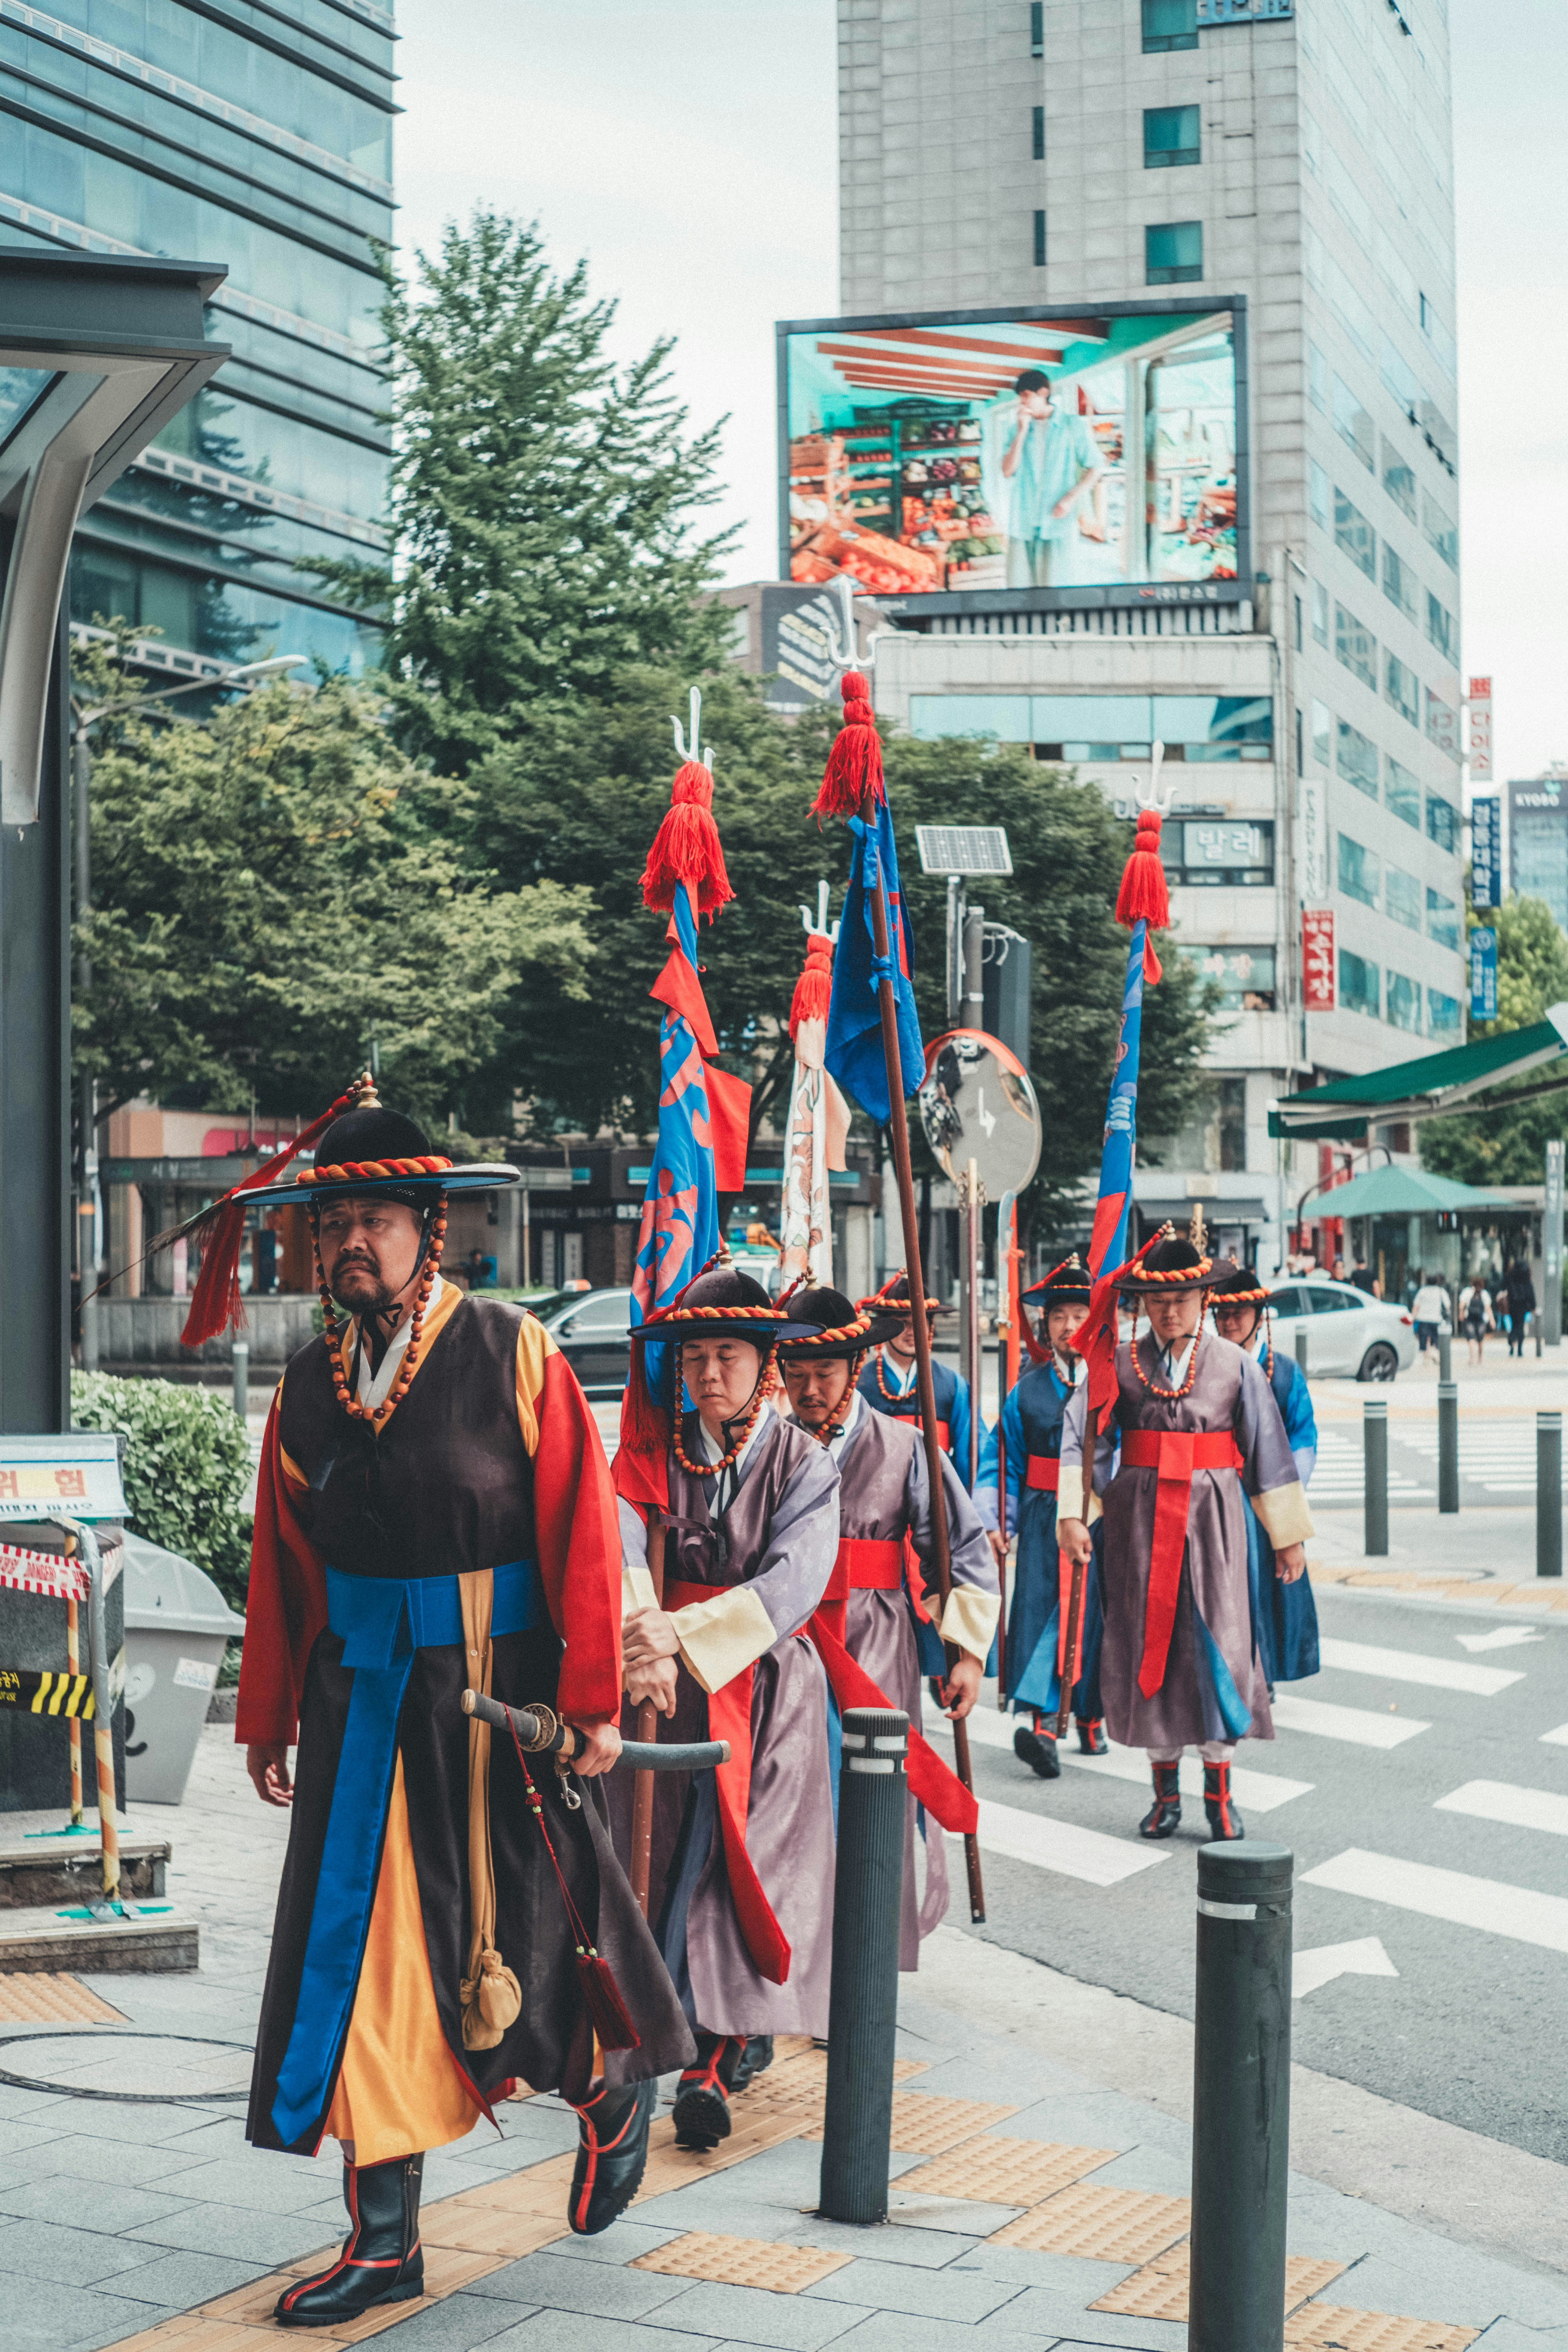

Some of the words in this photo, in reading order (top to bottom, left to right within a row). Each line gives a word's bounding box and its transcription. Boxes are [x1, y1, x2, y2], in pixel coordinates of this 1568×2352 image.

[1471, 711, 1490, 770] 다이소
[1515, 793, 1560, 807] KYOBO
[1197, 827, 1260, 860] 발레
[47, 1502, 92, 1511] 마시오
